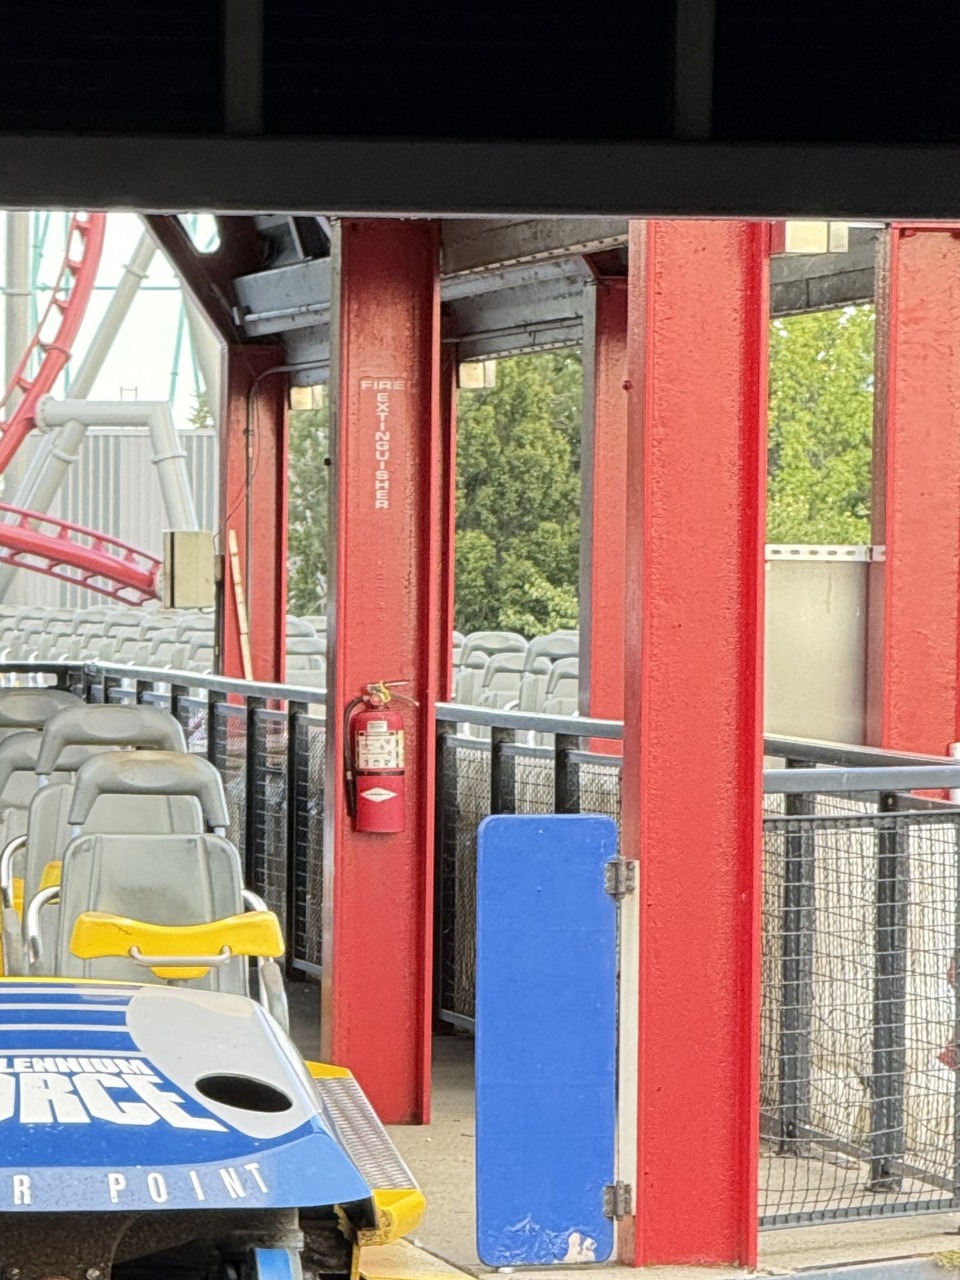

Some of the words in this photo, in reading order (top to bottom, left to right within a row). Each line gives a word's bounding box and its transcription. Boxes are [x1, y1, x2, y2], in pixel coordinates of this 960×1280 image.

[360, 380, 406, 391] FIRE
[375, 392, 390, 510] EXTINGUISHER
[109, 1161, 270, 1204] POINT
